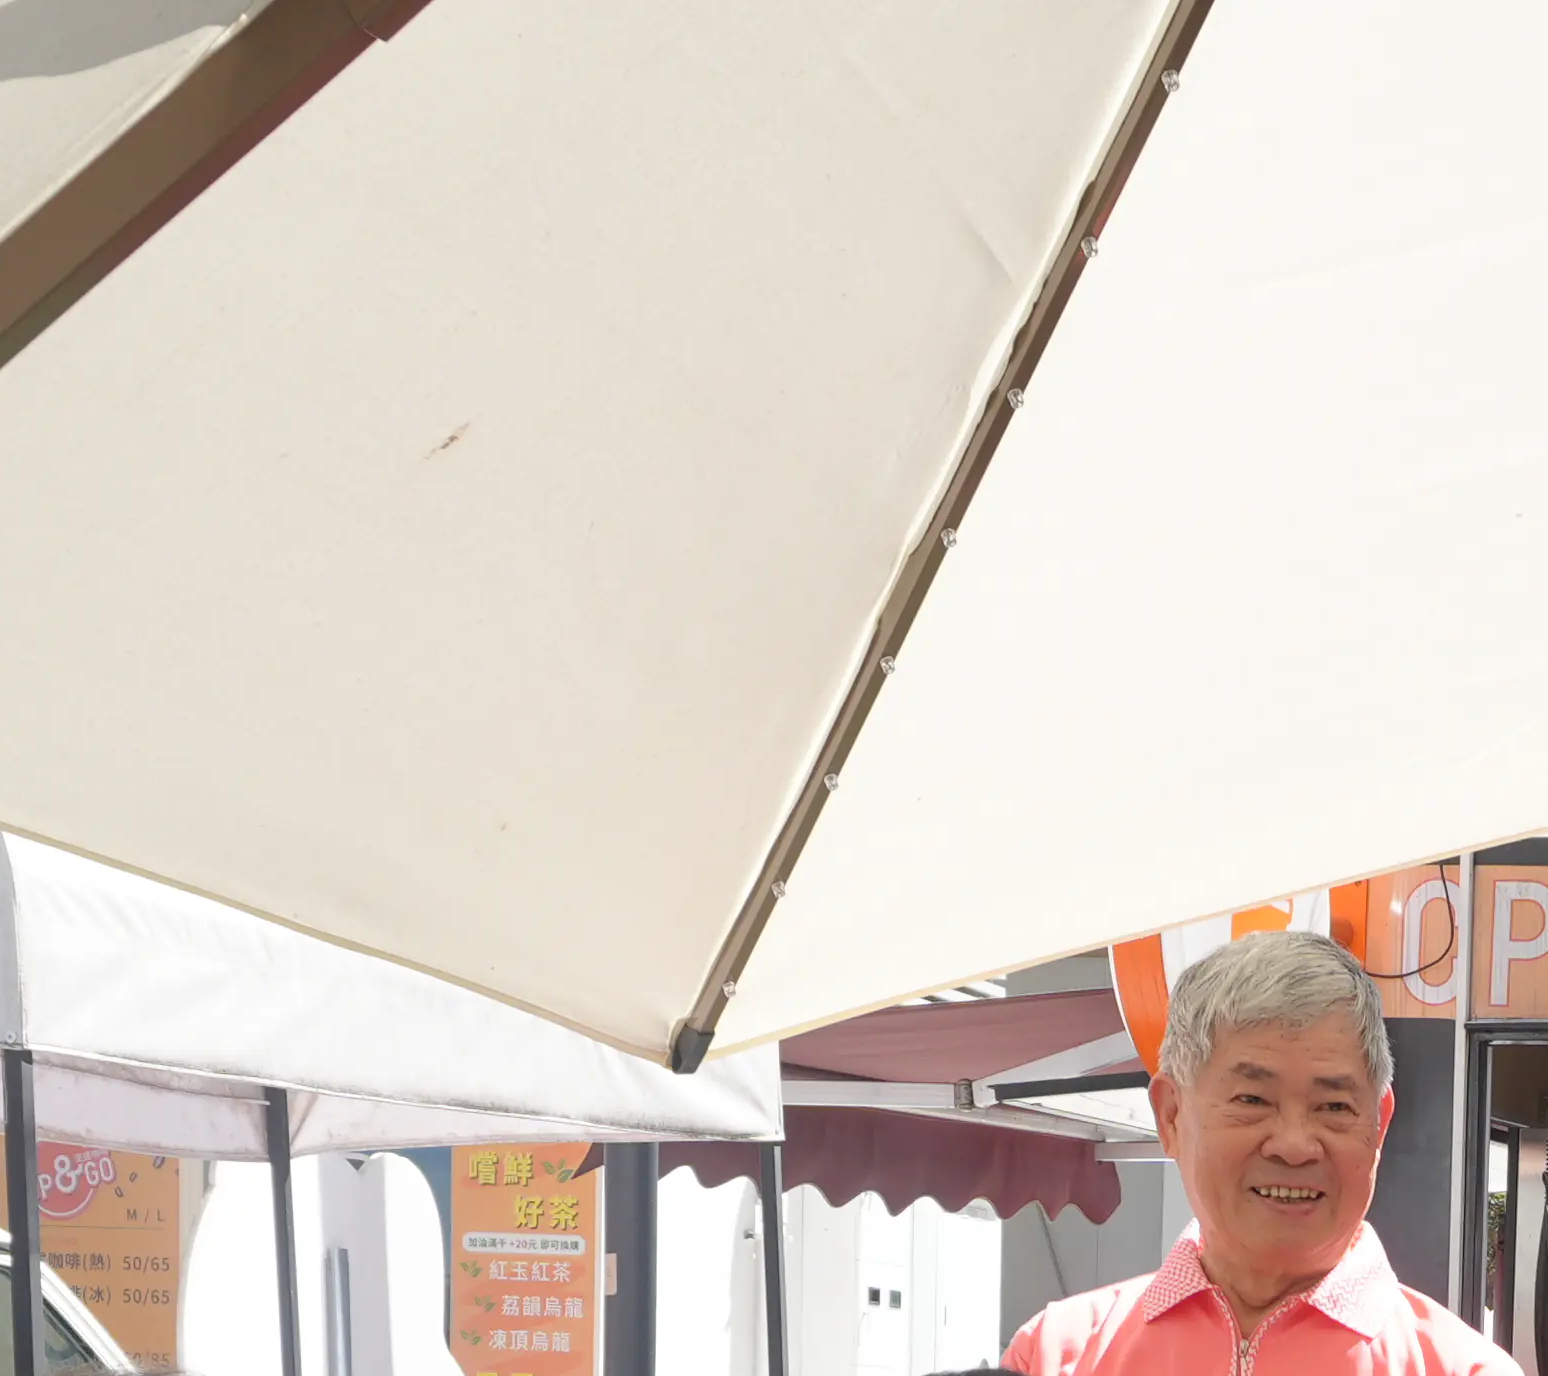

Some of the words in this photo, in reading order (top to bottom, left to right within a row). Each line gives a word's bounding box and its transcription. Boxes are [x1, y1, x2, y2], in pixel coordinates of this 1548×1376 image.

[85, 1157, 114, 1186] GO
[468, 1151, 534, 1187] 嚐鮮
[126, 1208, 138, 1222] M
[157, 1208, 166, 1222] L
[515, 1195, 580, 1231] 好茶
[40, 1252, 111, 1273] 咖啡(熱)
[122, 1255, 170, 1274] 50/65
[489, 1260, 572, 1282] 紅玉紅茶
[122, 1287, 170, 1306] 50/65
